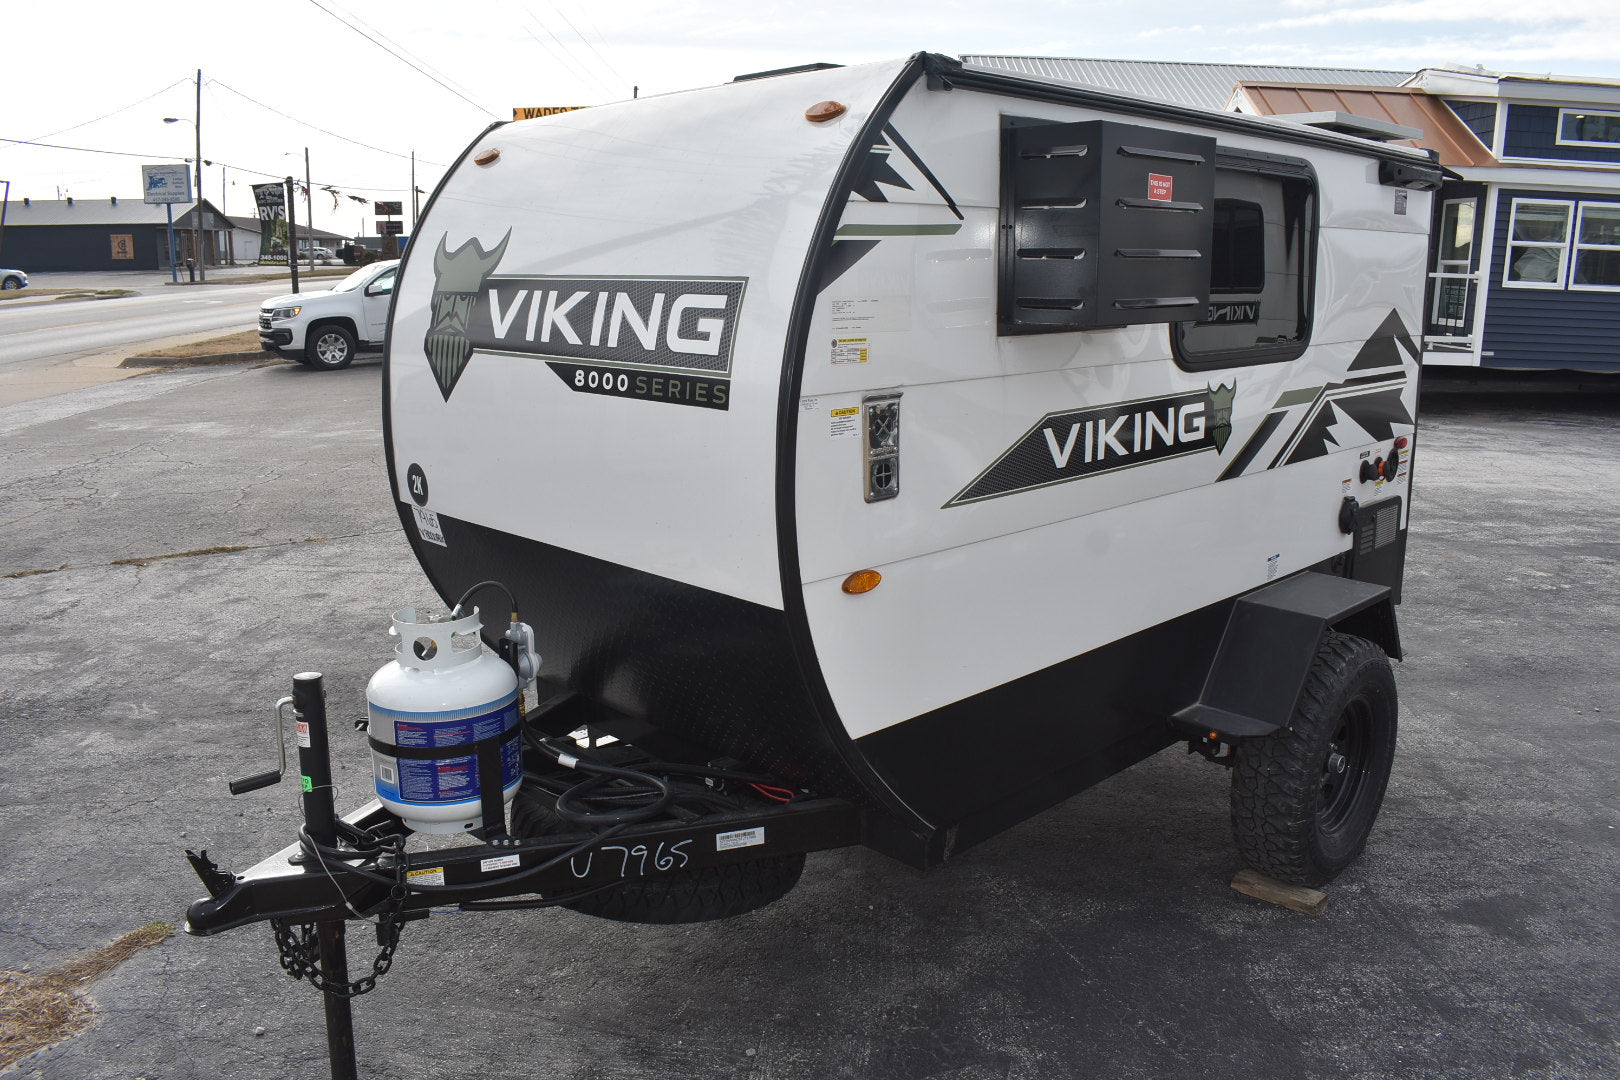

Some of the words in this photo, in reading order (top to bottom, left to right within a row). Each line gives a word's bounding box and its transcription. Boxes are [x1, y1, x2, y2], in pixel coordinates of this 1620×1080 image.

[259, 205, 285, 221] RV'S
[488, 288, 728, 356] VIKING
[574, 369, 629, 392] 8000
[635, 376, 727, 404] SERIES
[838, 408, 856, 416] CAUTION
[1043, 401, 1205, 469] VIKING
[412, 474, 424, 496] 2K
[414, 868, 437, 877] CAUTION
[570, 851, 593, 879] U
[600, 839, 693, 878] 7965
